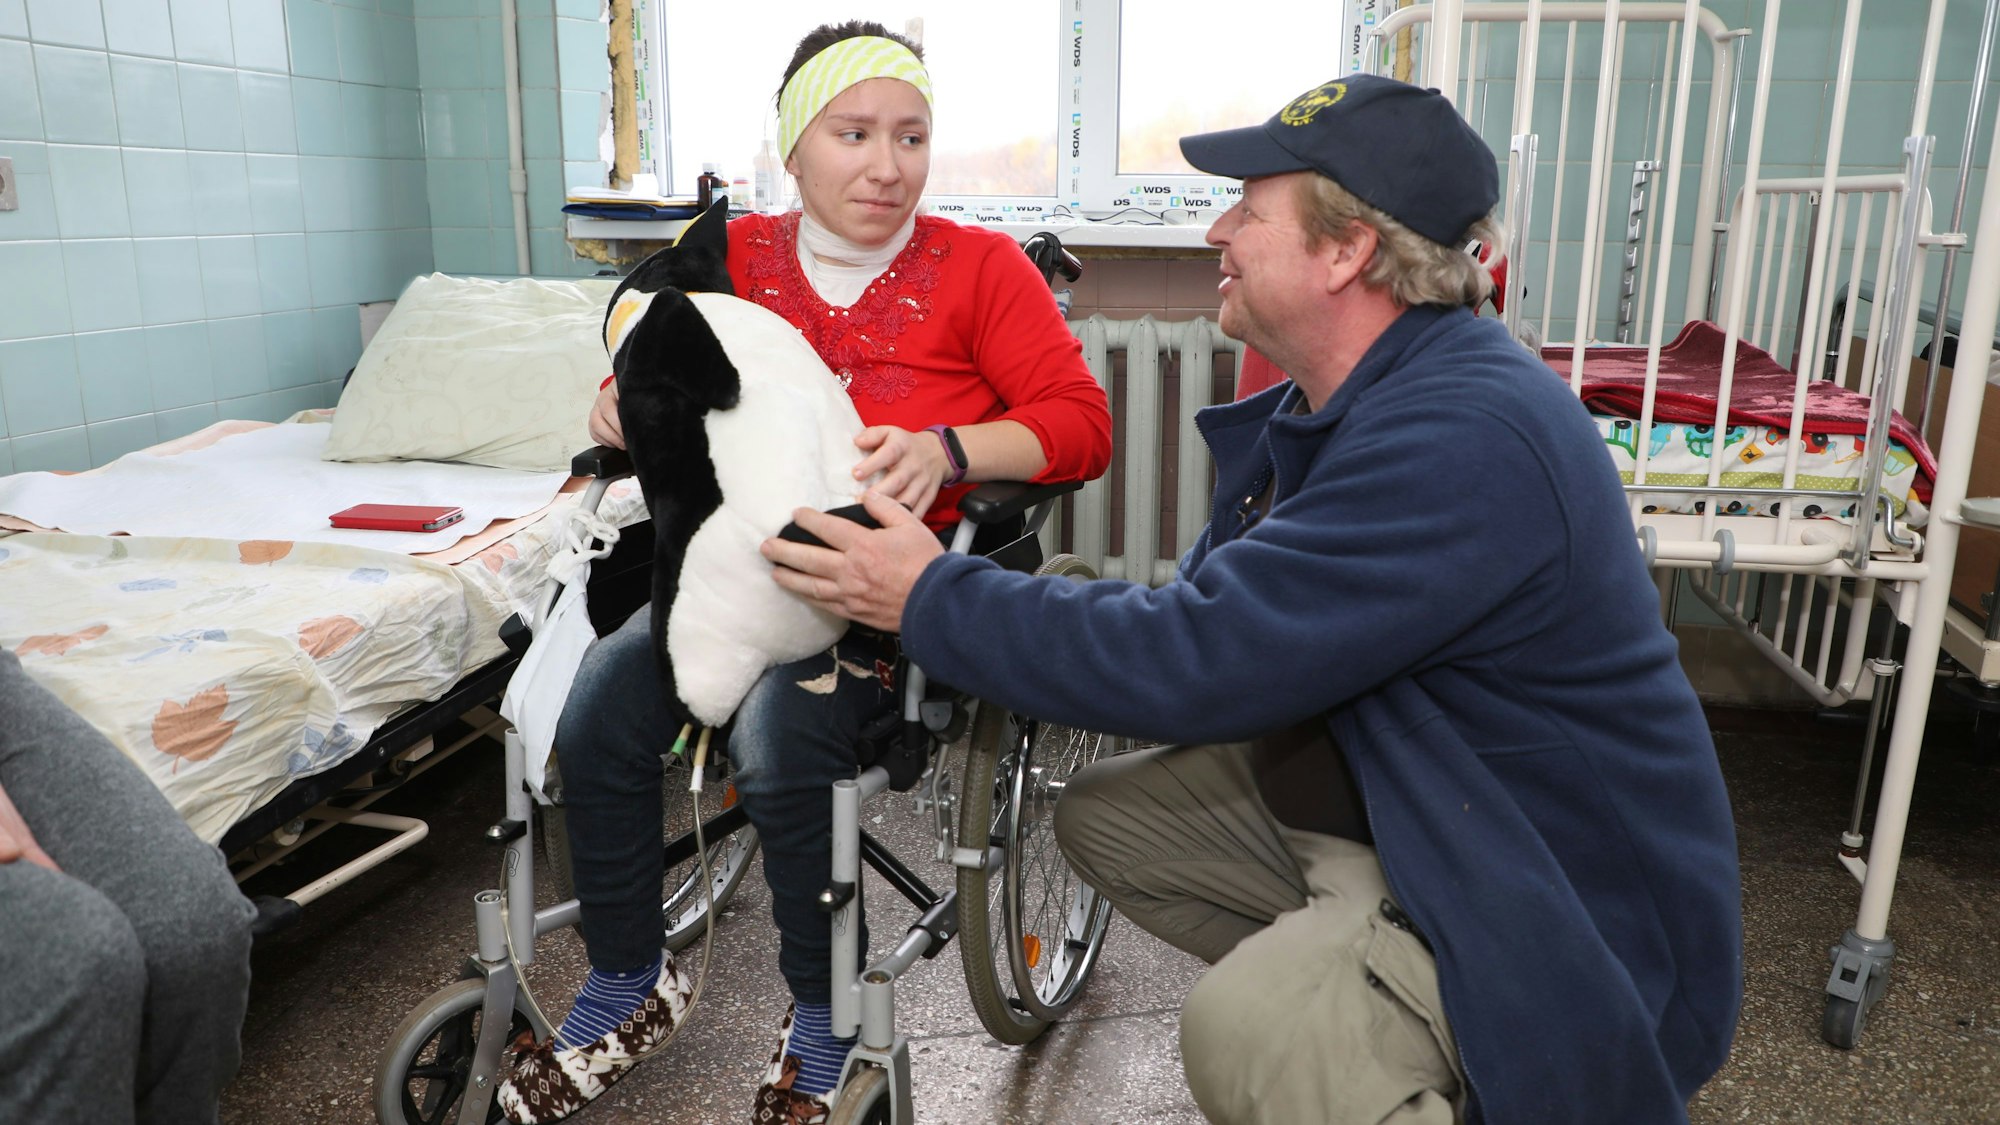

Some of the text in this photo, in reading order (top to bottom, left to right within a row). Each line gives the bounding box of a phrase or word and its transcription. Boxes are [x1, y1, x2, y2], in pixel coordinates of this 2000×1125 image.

[1073, 36, 1082, 67] WDS
[1353, 24, 1361, 55] WDS
[1072, 128, 1081, 158] WDS
[1143, 186, 1171, 194] WDS
[1183, 197, 1212, 207] WDS
